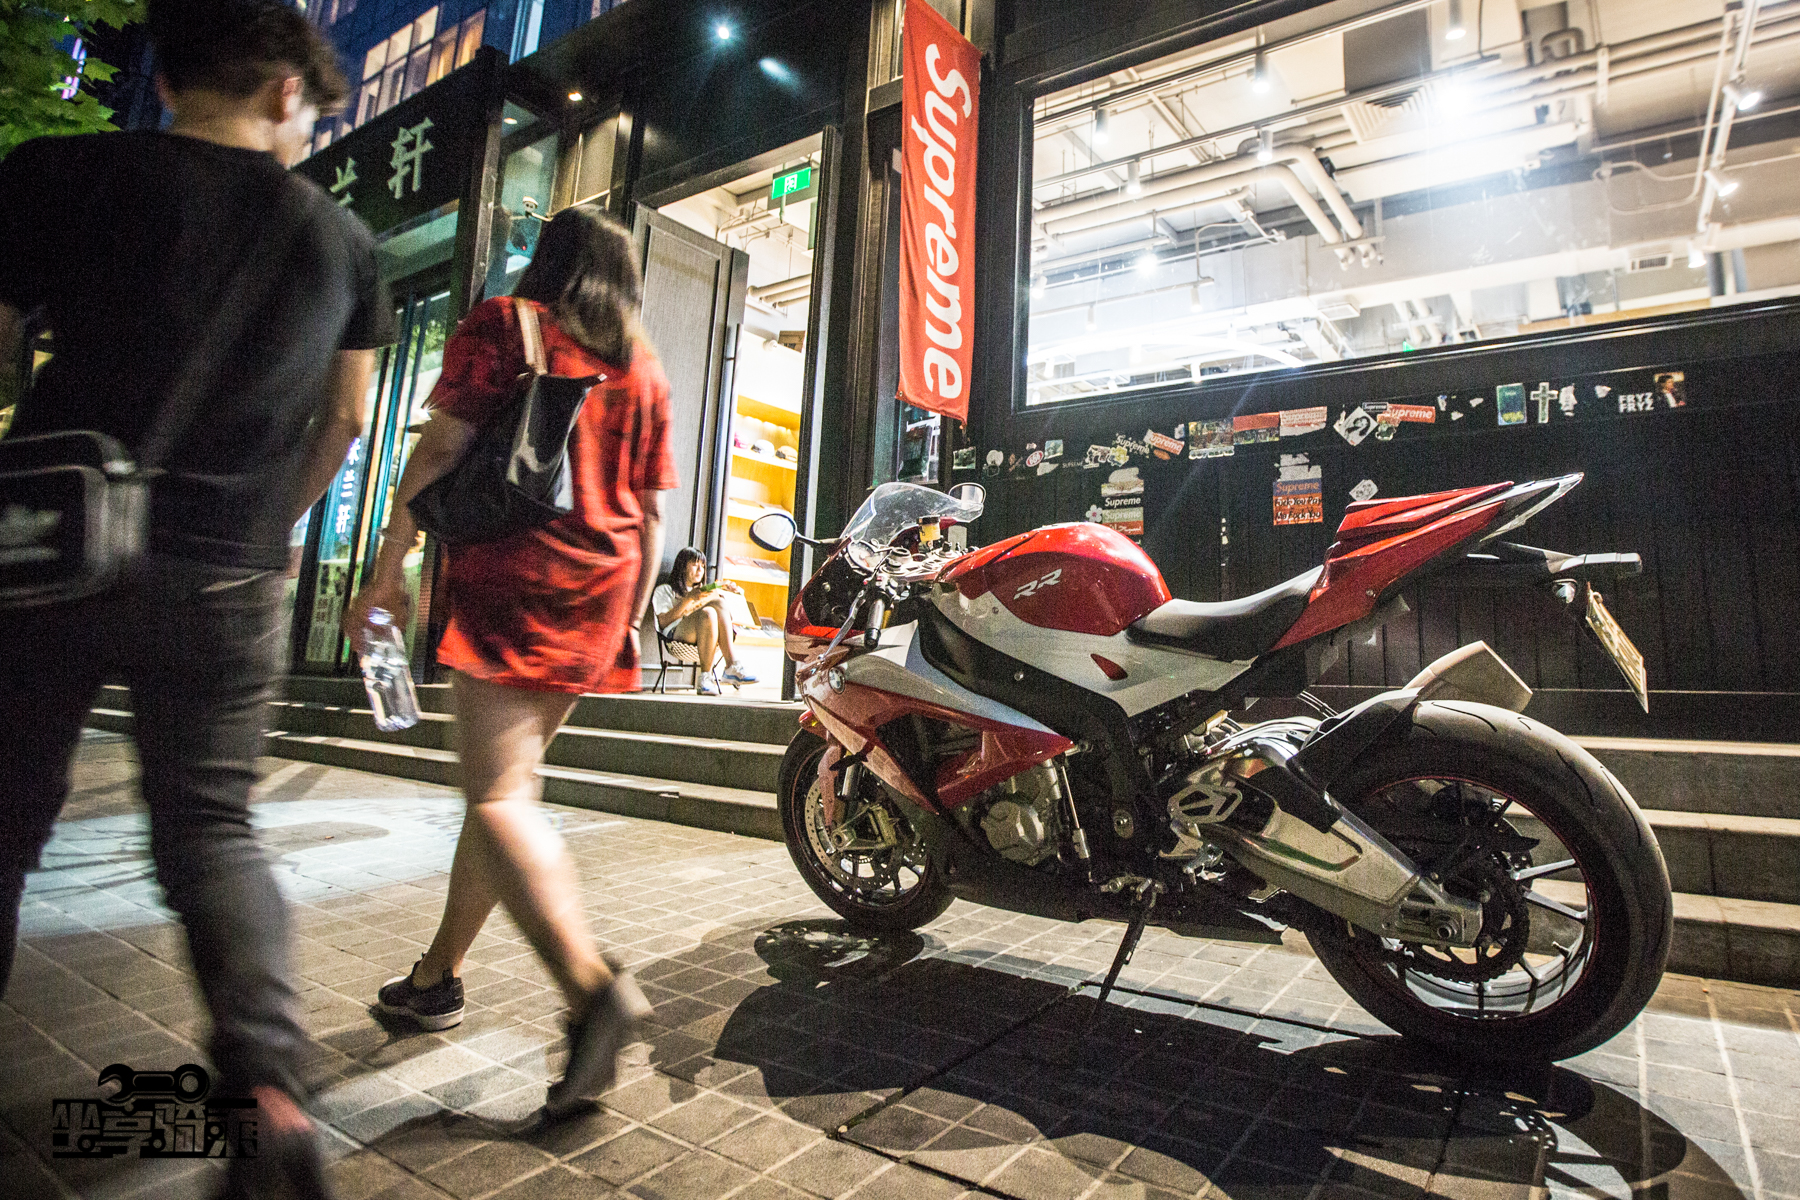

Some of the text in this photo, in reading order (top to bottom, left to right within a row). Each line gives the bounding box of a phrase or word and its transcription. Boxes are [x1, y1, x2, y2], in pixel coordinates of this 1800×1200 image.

[910, 42, 972, 400] Supreme
[1619, 402, 1655, 414] FRYZ
[1276, 481, 1320, 495] Supreme
[1104, 497, 1142, 508] Supreme
[1105, 509, 1142, 521] Supreme
[1013, 568, 1063, 601] RR
